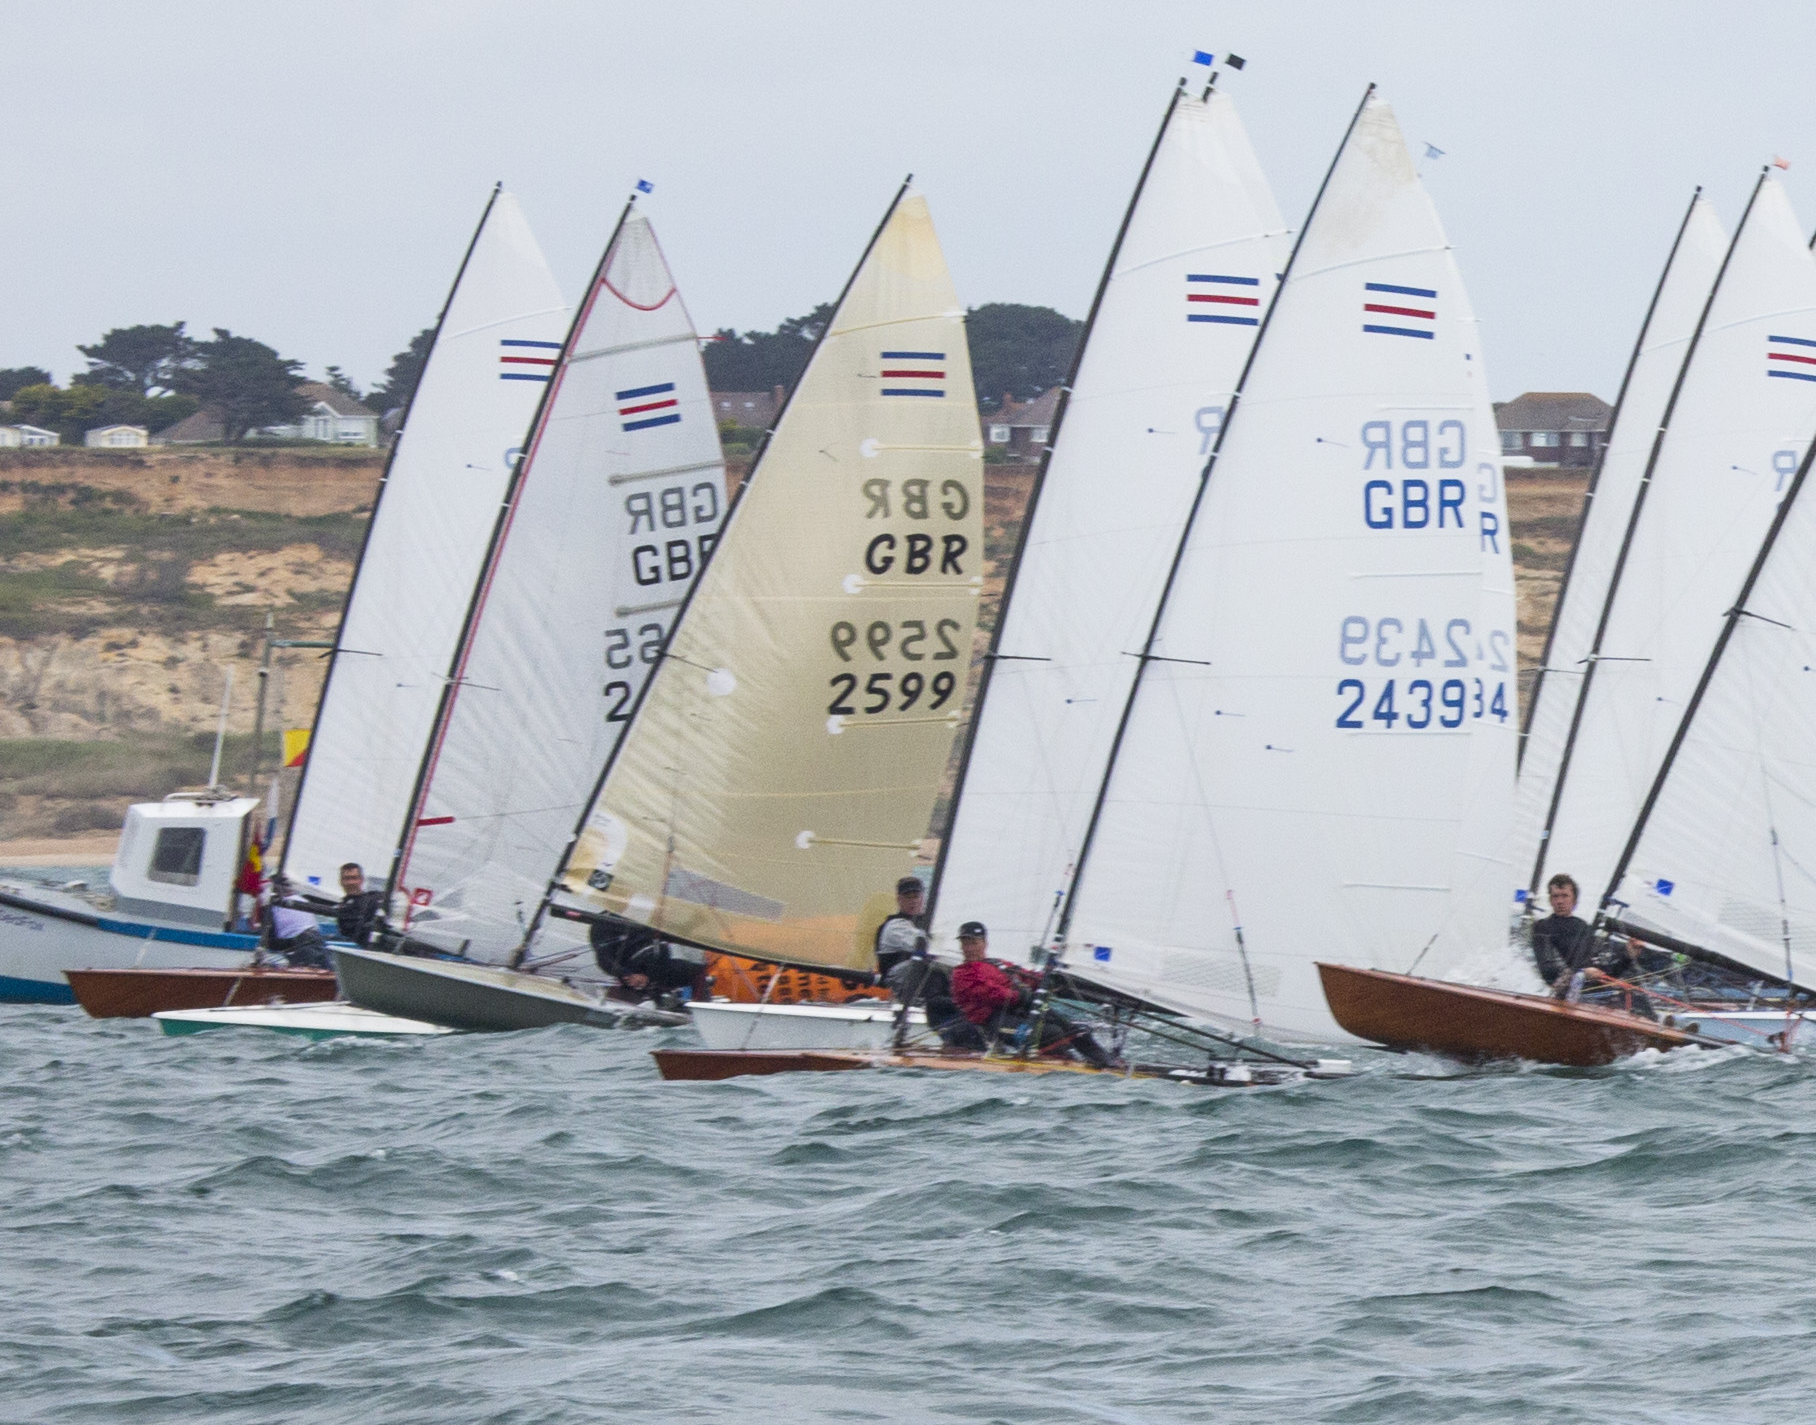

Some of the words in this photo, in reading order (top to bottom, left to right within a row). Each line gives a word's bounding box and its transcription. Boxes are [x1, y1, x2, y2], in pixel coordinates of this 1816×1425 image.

[1364, 479, 1465, 529] GBR
[865, 533, 968, 575] GBR
[827, 672, 956, 715] 2599
[1336, 679, 1465, 729] 2439
[1473, 677, 1509, 723] 34
